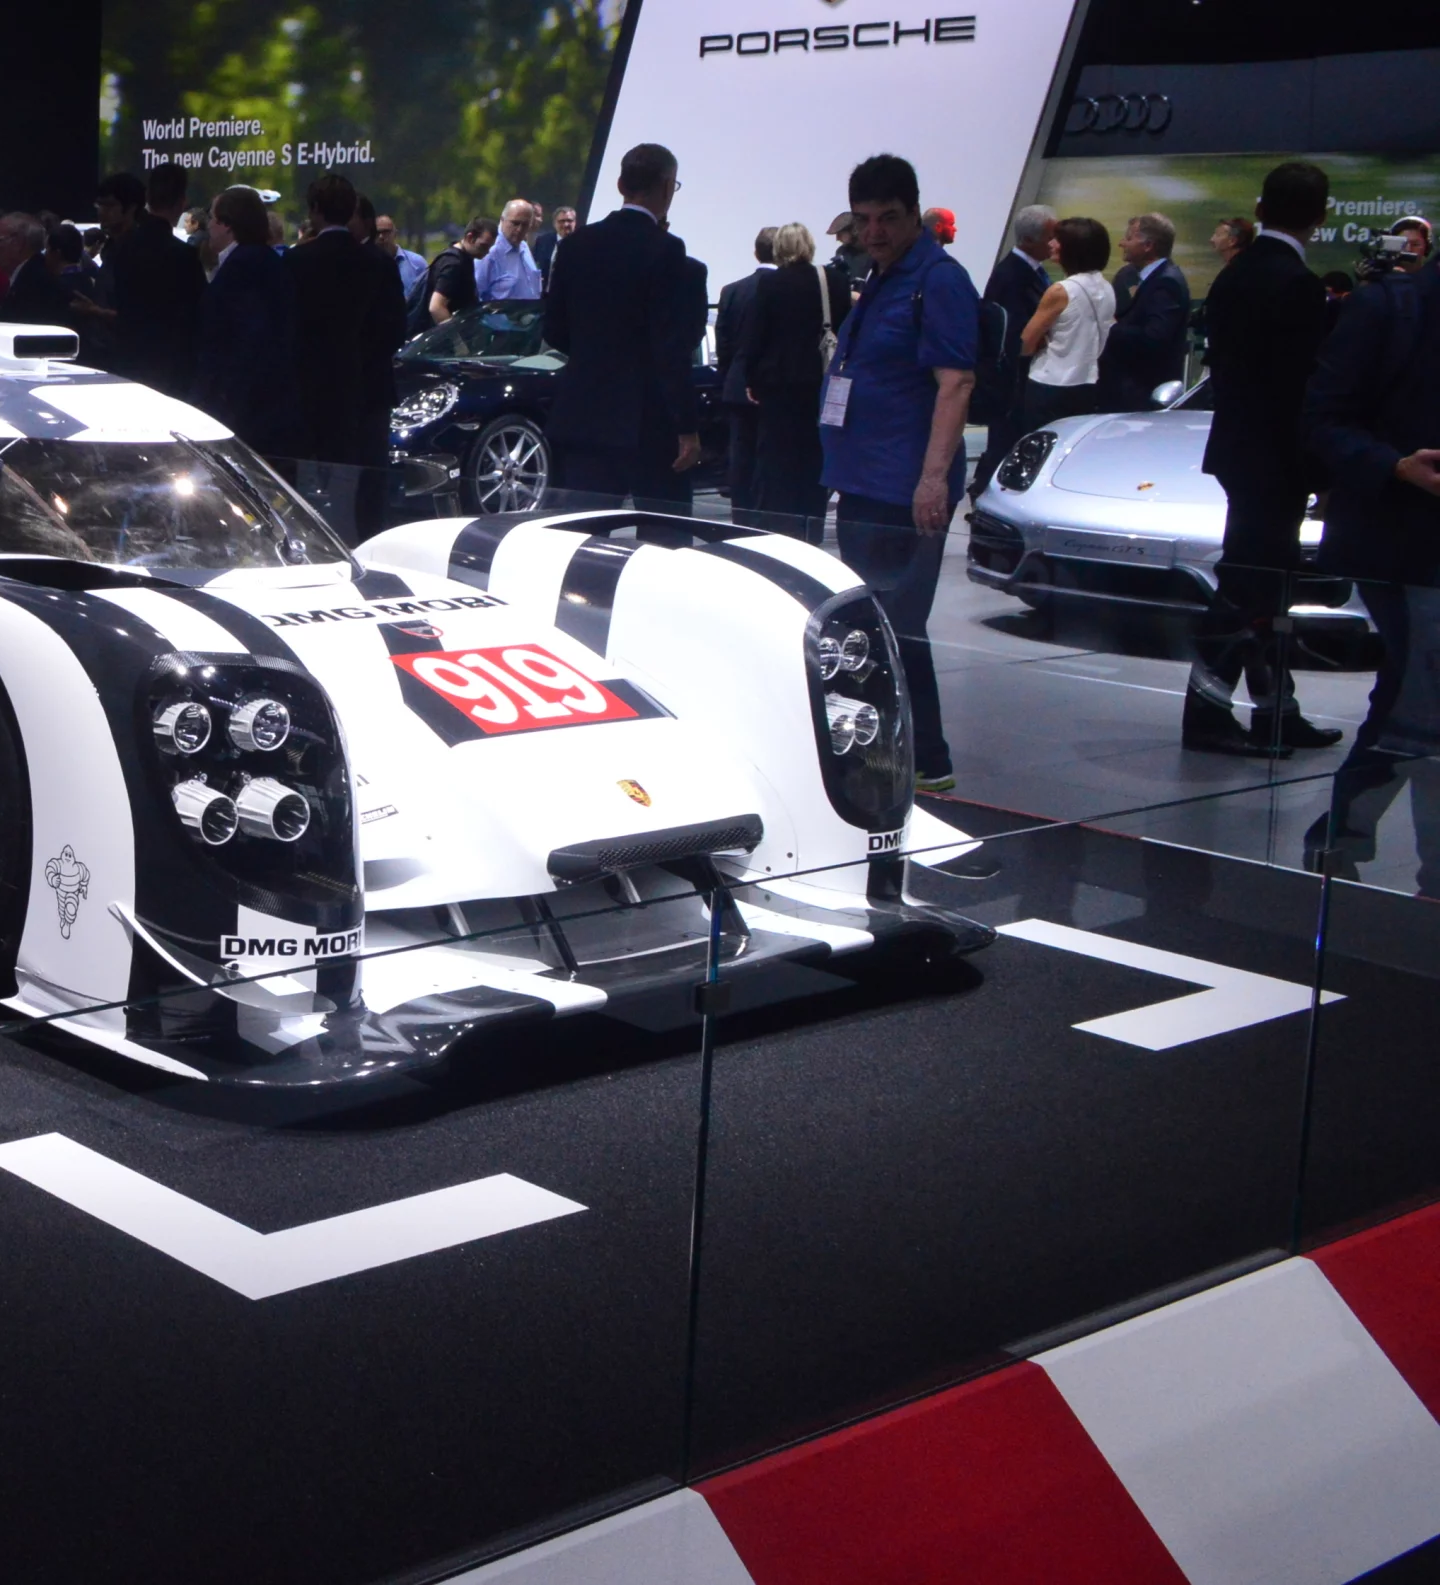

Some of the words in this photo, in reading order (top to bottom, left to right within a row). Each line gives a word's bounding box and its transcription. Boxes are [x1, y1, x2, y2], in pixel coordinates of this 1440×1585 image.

[699, 15, 976, 58] PORSCHE
[142, 117, 185, 140] World
[189, 115, 265, 139] Premiere.
[142, 148, 169, 169] The
[173, 151, 203, 168] new
[207, 145, 276, 172] Cayenne
[281, 143, 292, 166] S
[297, 140, 376, 170] E-Hybrid.
[1309, 228, 1337, 242] ew
[411, 648, 608, 725] 919
[224, 937, 298, 956] DMG
[303, 929, 362, 956] MORI
